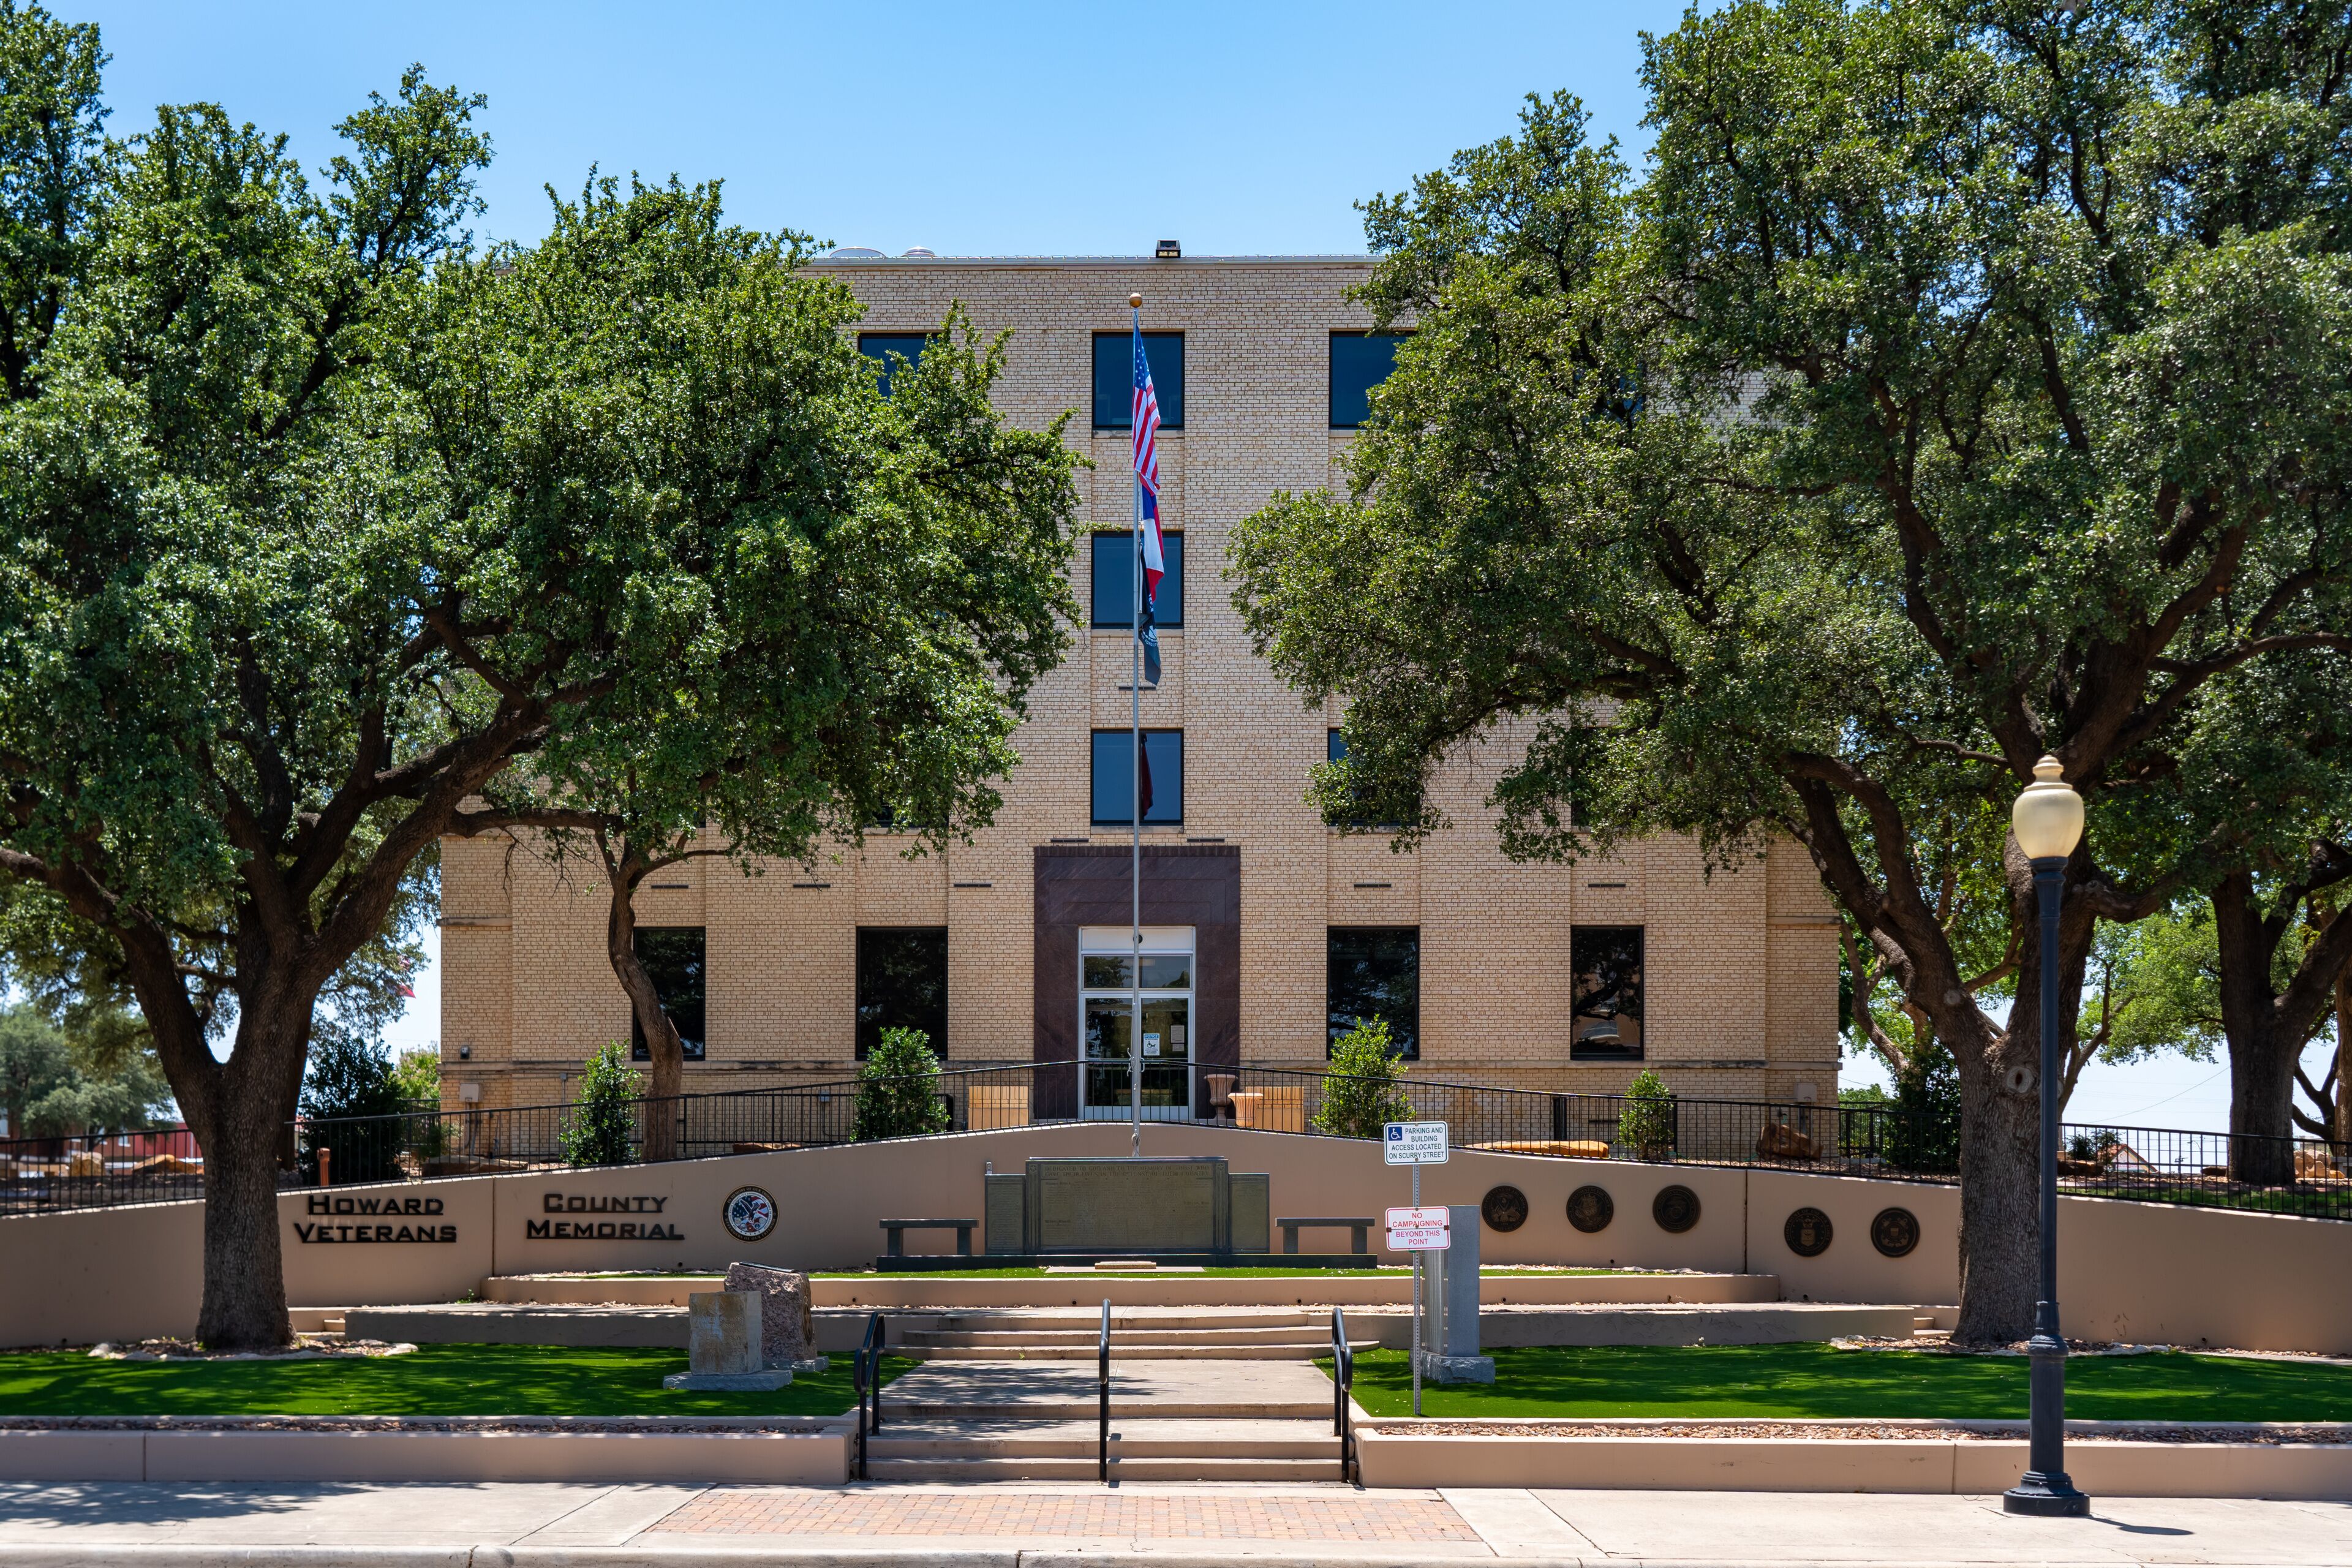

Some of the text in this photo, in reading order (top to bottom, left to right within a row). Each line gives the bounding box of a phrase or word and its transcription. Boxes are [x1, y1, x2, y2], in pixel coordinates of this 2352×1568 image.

[307, 1194, 668, 1216] HOWARD COUNTY
[293, 1219, 685, 1244] VETERANS MEMORIAL
